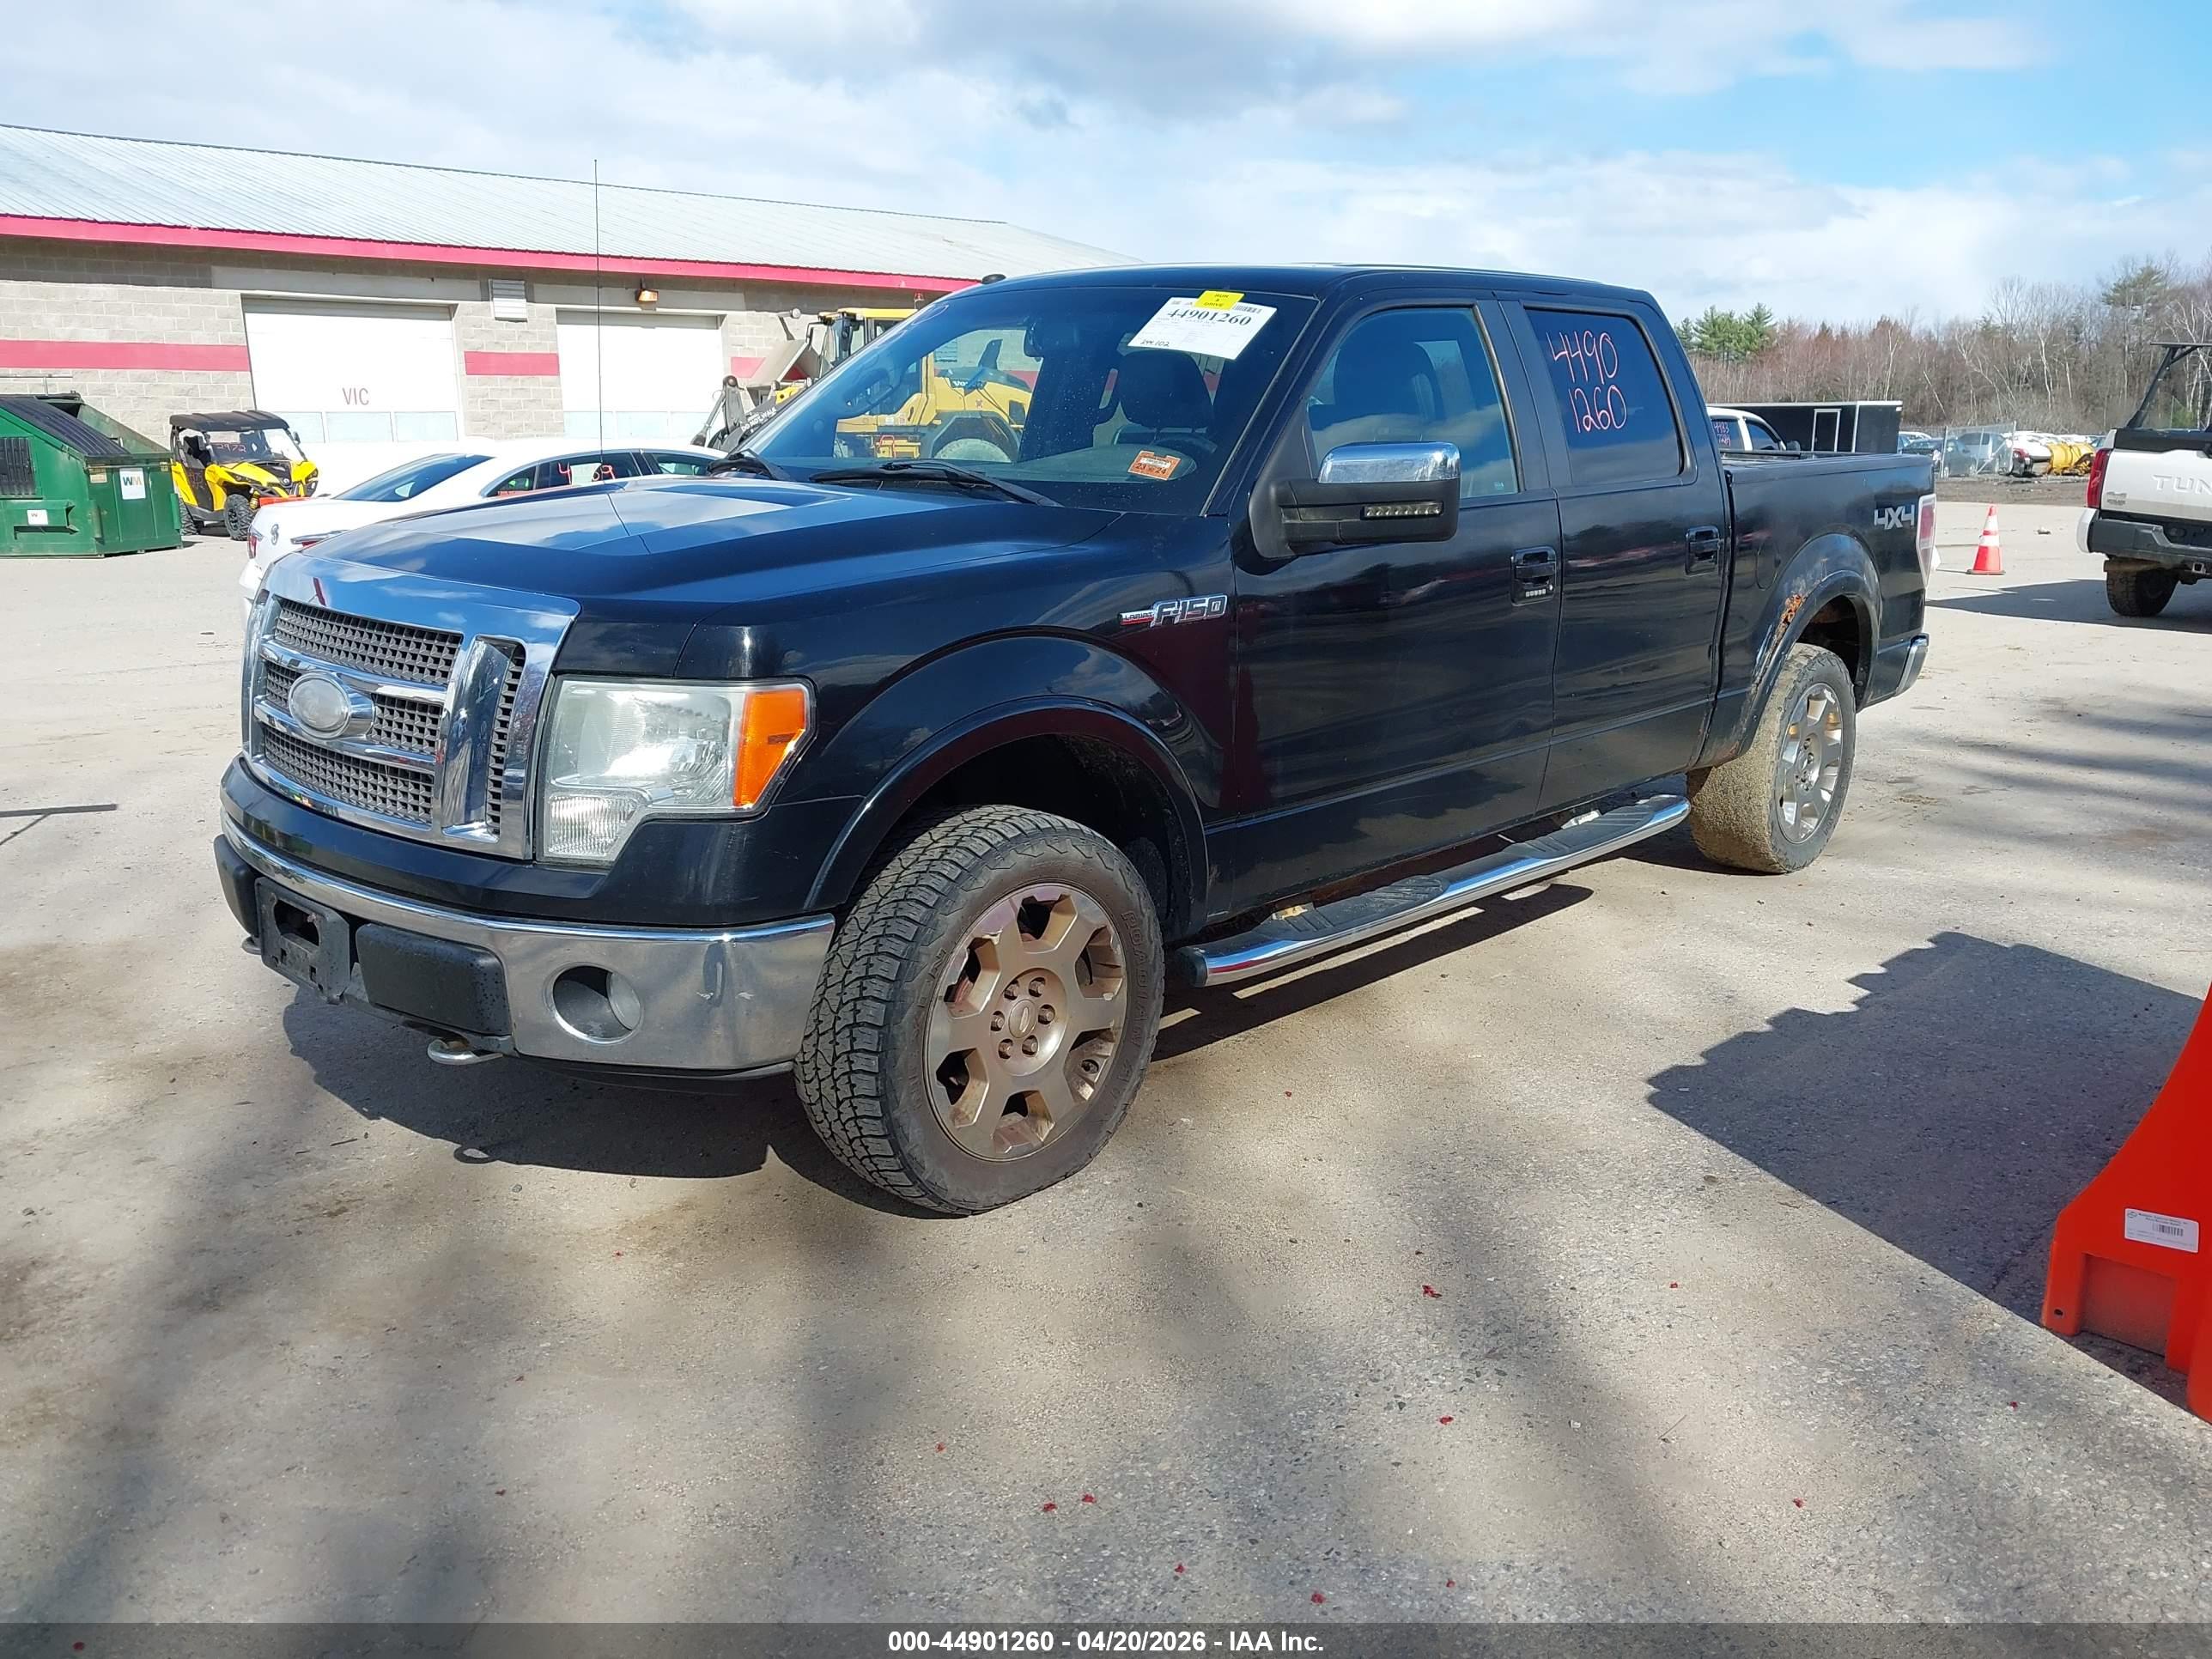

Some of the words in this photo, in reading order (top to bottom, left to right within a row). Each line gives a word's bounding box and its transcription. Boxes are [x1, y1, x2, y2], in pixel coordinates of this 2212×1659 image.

[1168, 308, 1252, 326] 44901260
[1546, 330, 1619, 386] 4490
[342, 386, 370, 406] VIC
[1568, 384, 1627, 434] 1260
[123, 476, 142, 486] WM
[1126, 611, 1154, 621] LARIAT
